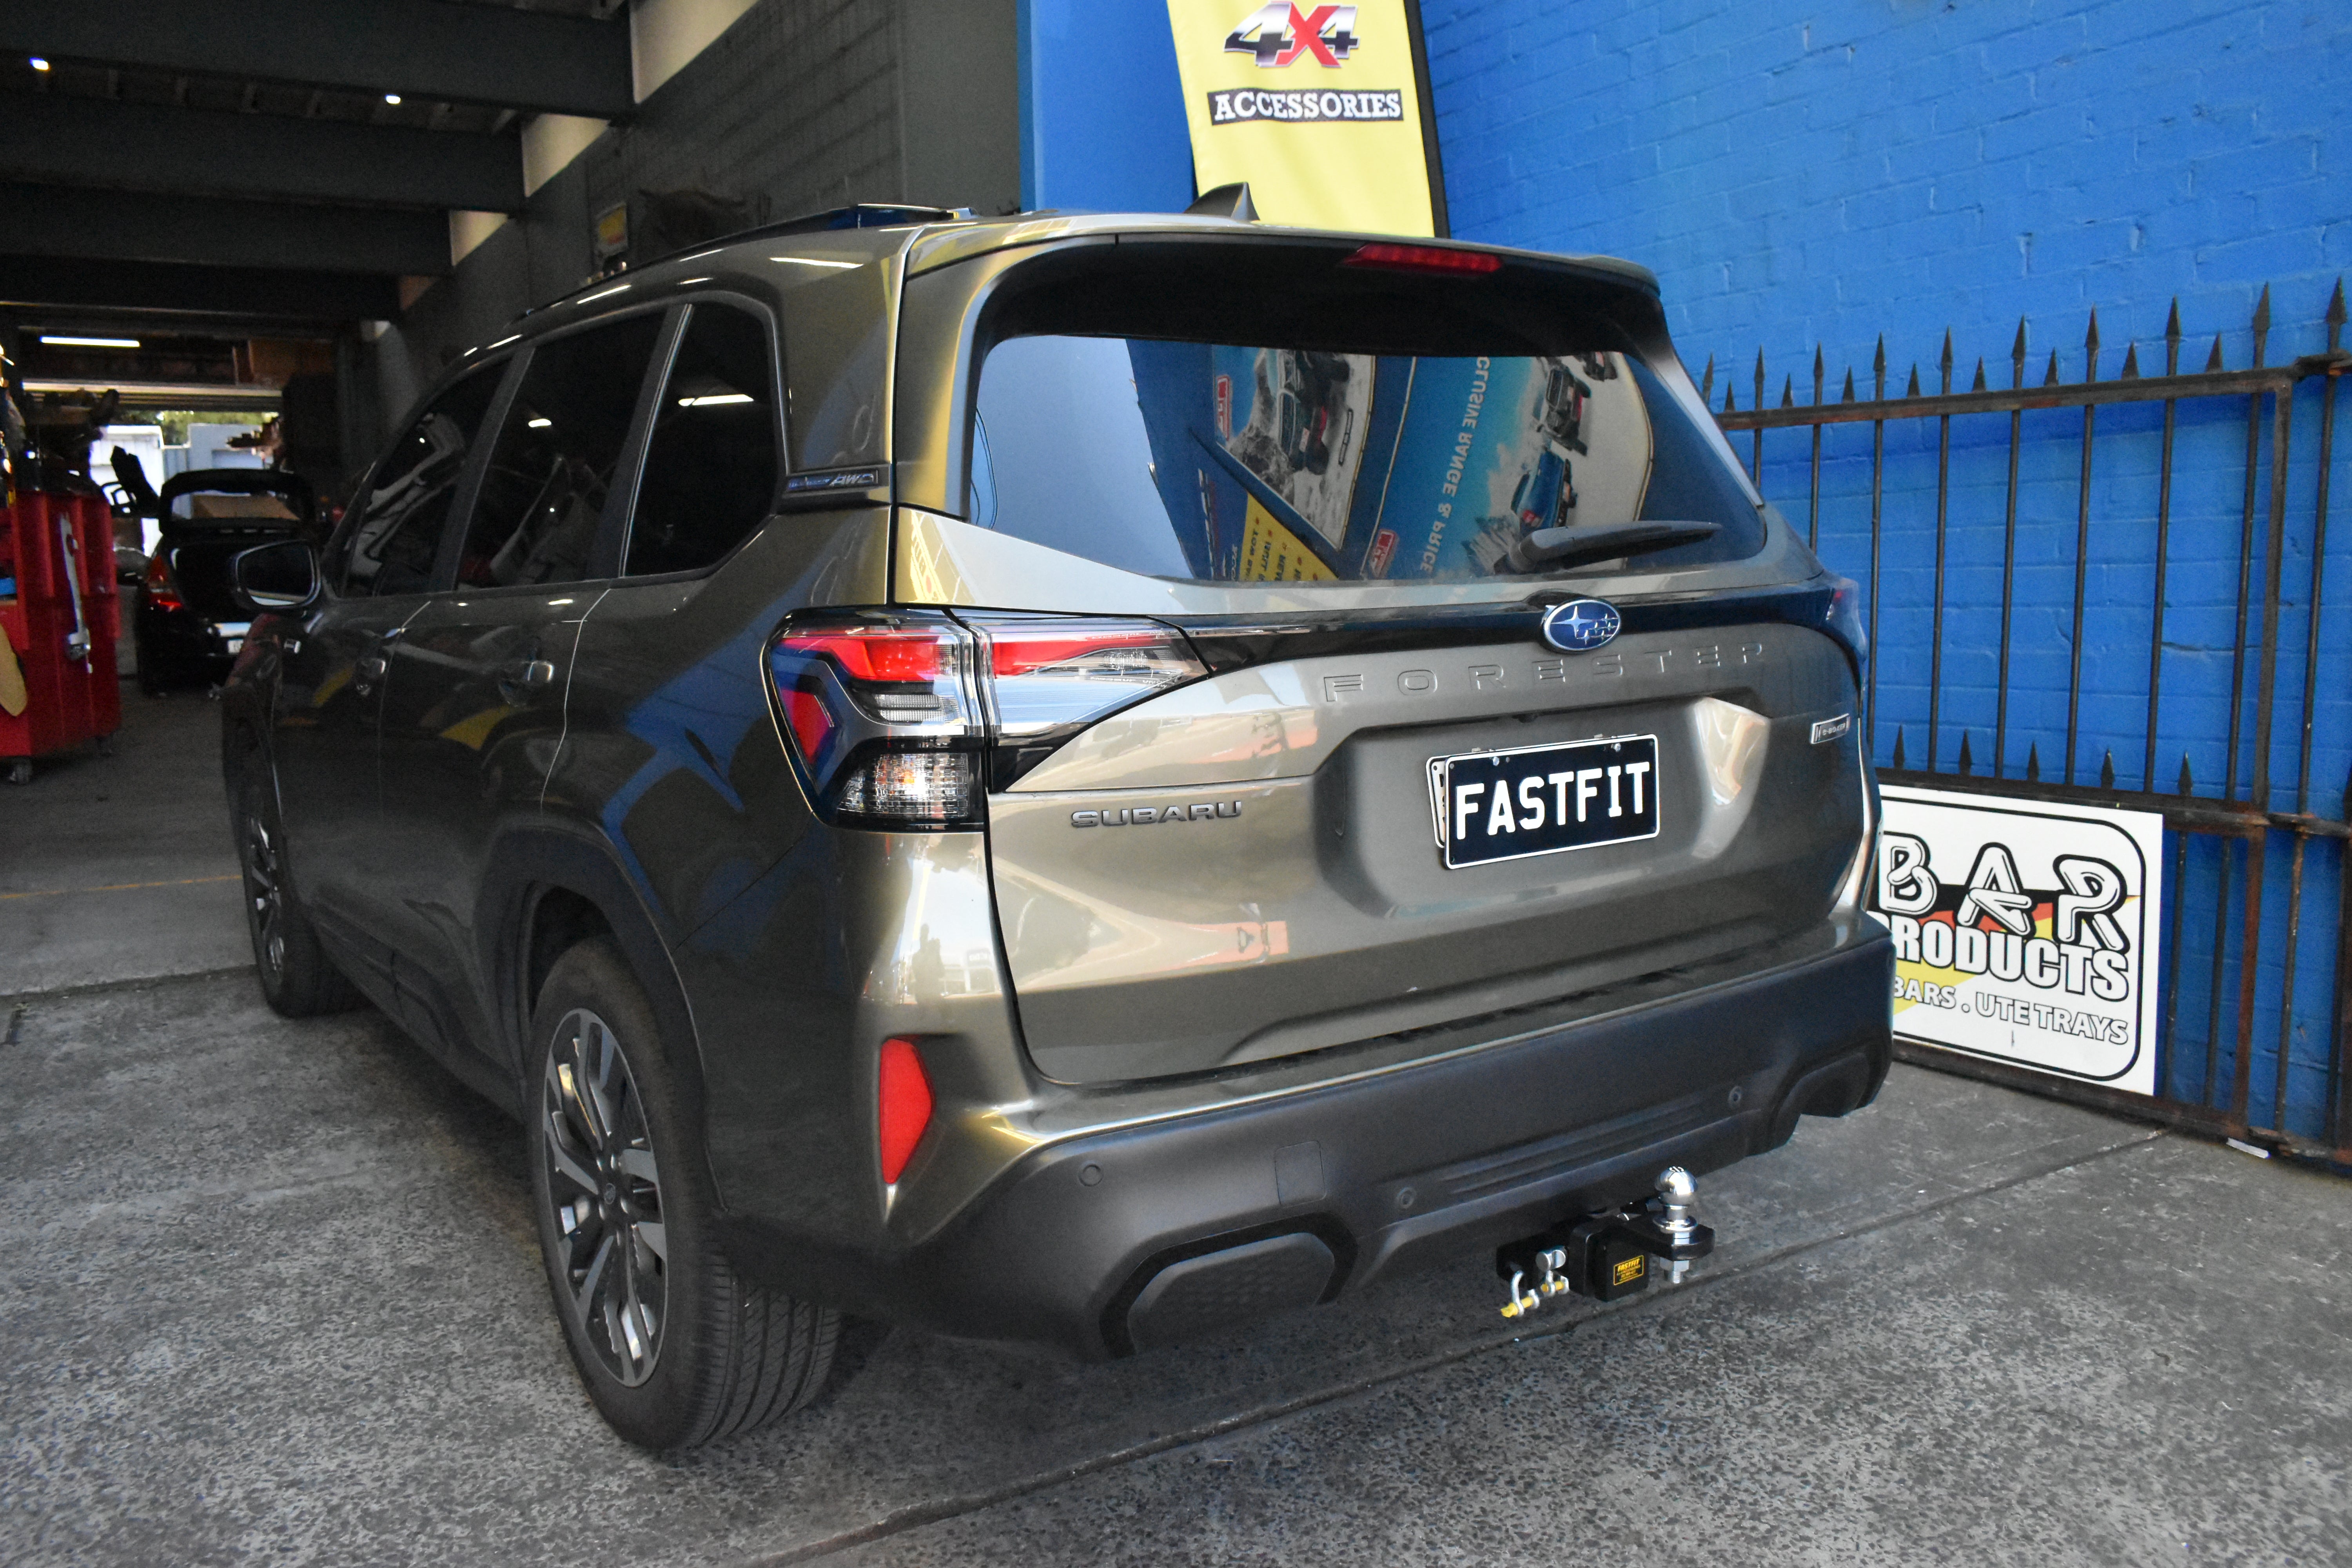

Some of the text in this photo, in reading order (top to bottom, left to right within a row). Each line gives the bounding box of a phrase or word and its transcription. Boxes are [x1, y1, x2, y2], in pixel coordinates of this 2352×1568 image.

[1214, 90, 1401, 121] ACCESSORIES
[1323, 641, 1764, 702] FORESTER
[1071, 800, 1242, 828] SUBARU
[1455, 761, 1650, 840] FASTFIT
[1879, 830, 2130, 953] BAR
[1894, 976, 1956, 1009] BARS
[1976, 991, 2030, 1025] UTE
[2034, 1003, 2129, 1045] TRAYS
